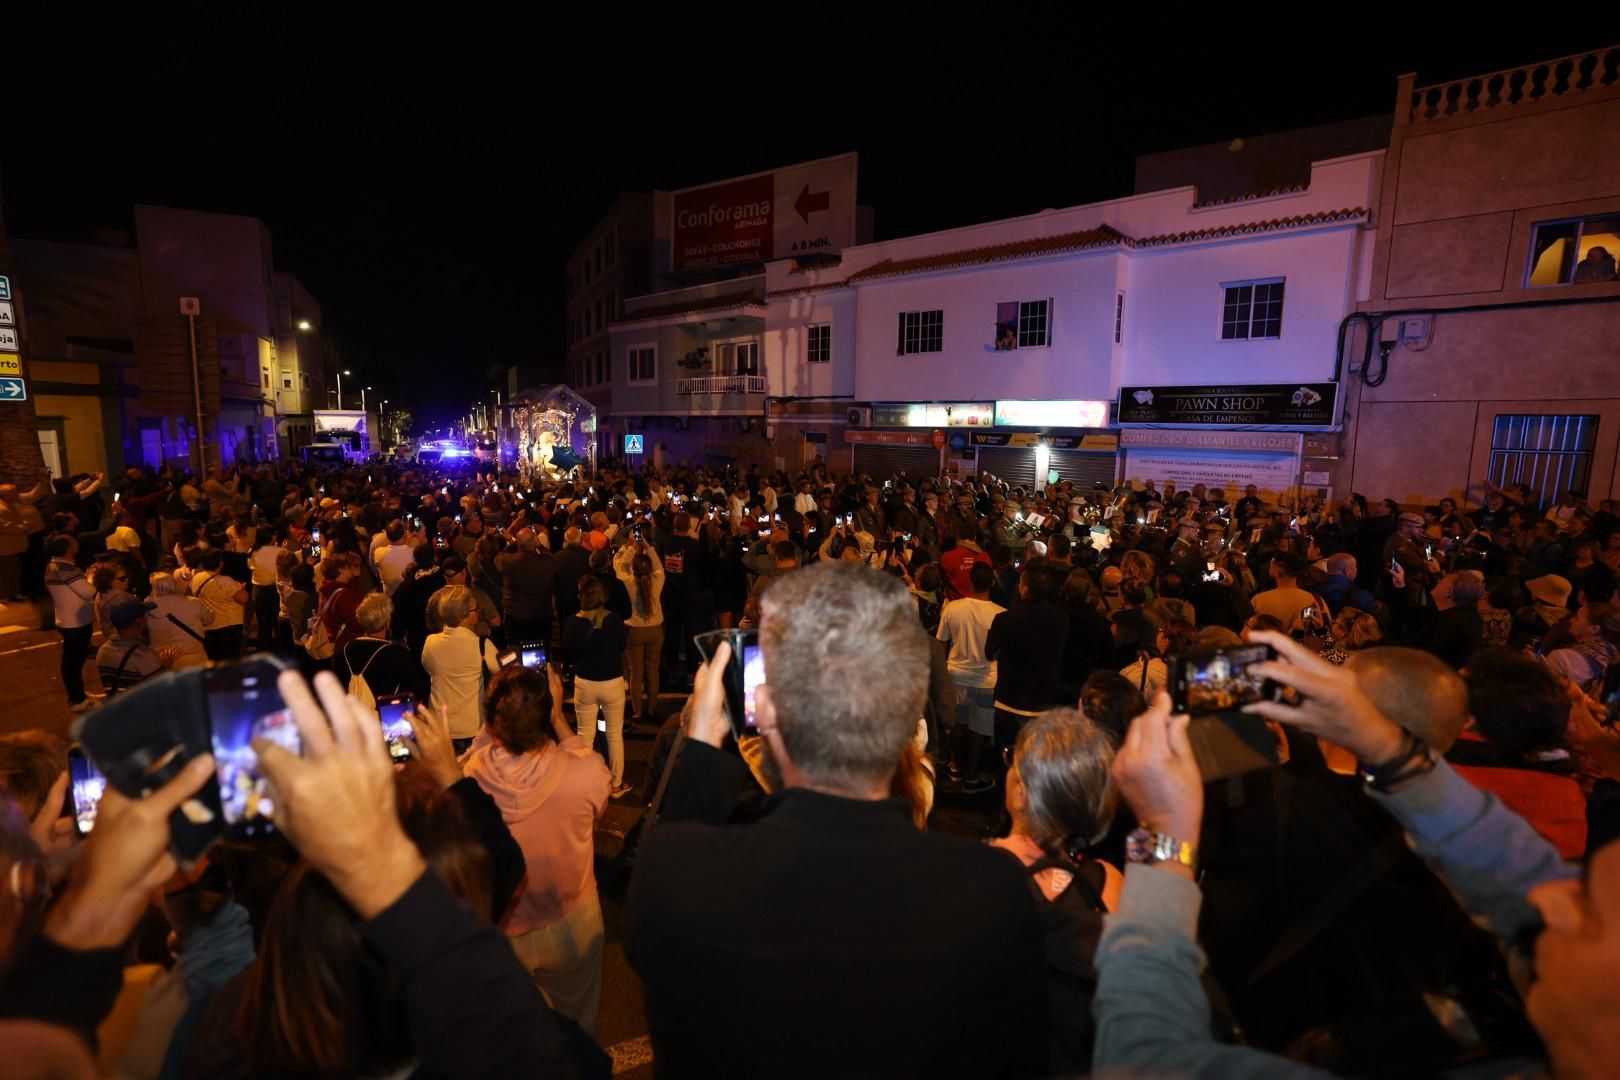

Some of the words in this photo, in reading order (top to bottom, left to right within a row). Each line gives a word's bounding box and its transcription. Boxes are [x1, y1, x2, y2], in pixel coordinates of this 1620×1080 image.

[677, 200, 771, 229] Conforama
[713, 238, 762, 253] COLCHONES
[791, 243, 799, 251] A
[809, 237, 832, 249] MIN.
[1176, 397, 1219, 411] PAWN
[1222, 397, 1266, 411] SHOP
[1203, 415, 1214, 423] DE
[1122, 434, 1160, 444] COMPRO
[1163, 434, 1183, 444] ORO
[1187, 435, 1240, 446] DIAMANTES
[1252, 437, 1293, 448] RELOJES
